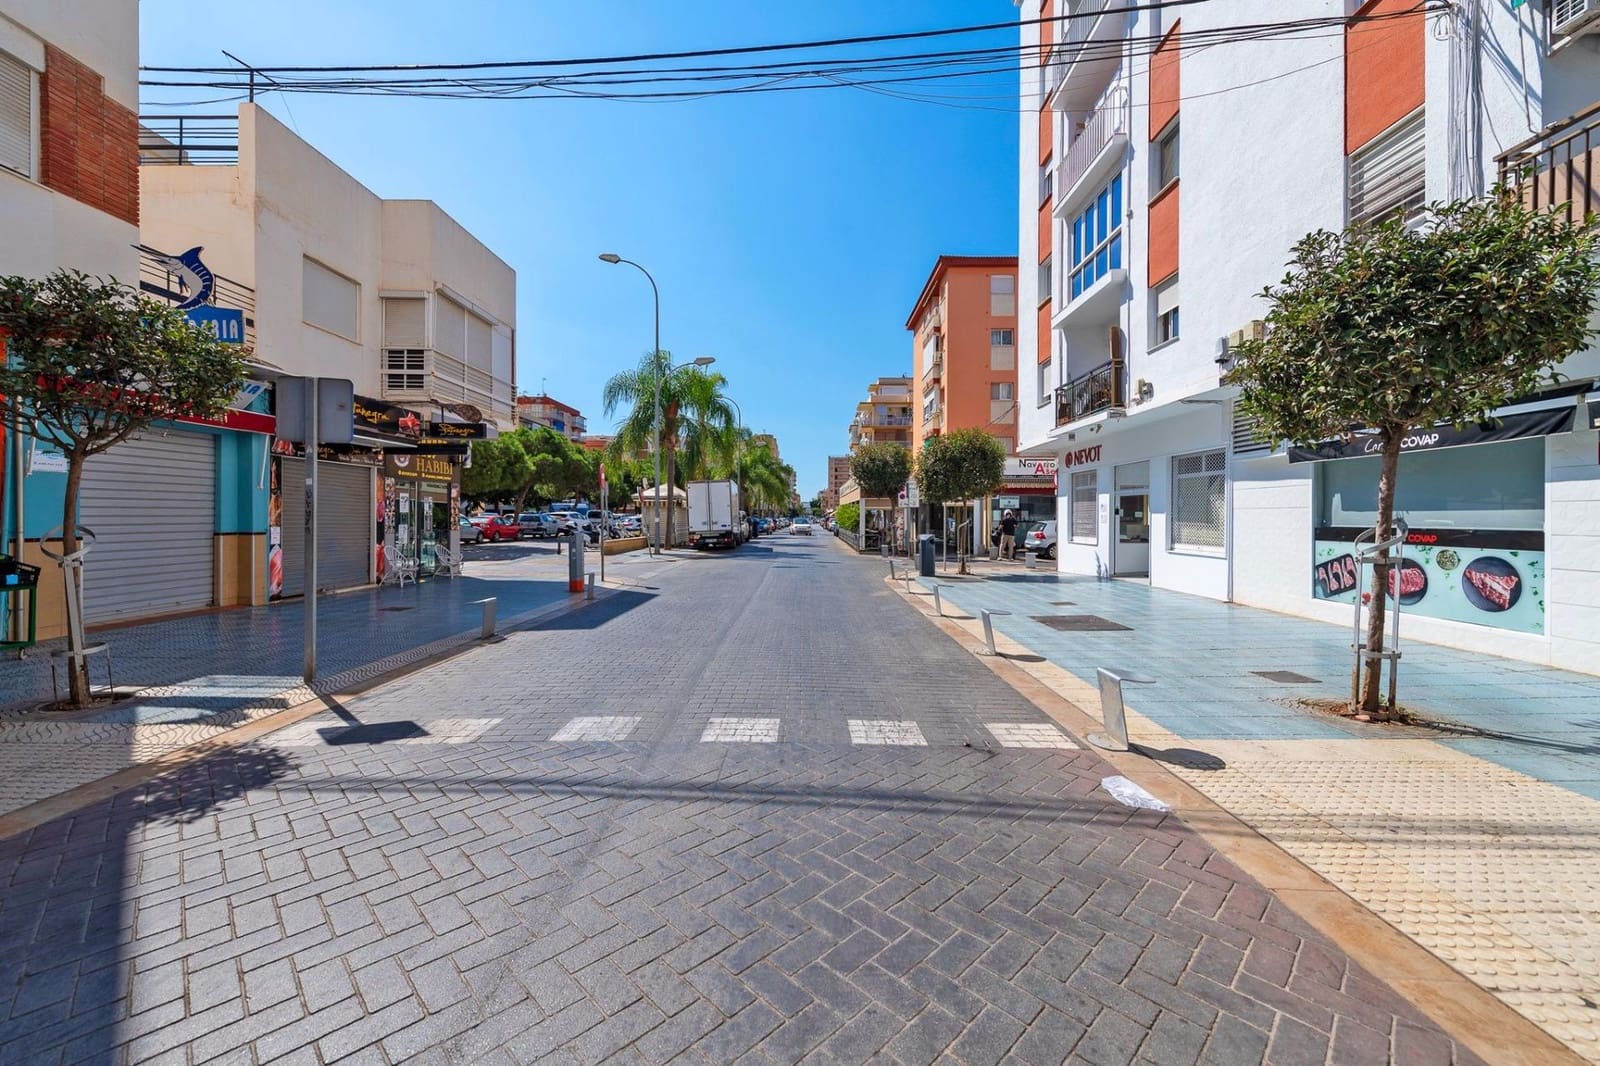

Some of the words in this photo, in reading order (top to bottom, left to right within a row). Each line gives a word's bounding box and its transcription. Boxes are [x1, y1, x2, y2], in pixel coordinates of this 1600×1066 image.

[1400, 433, 1440, 448] COVAP
[1073, 445, 1103, 466] NEVOT
[416, 457, 454, 475] HABIBI
[1408, 534, 1438, 544] COVAP
